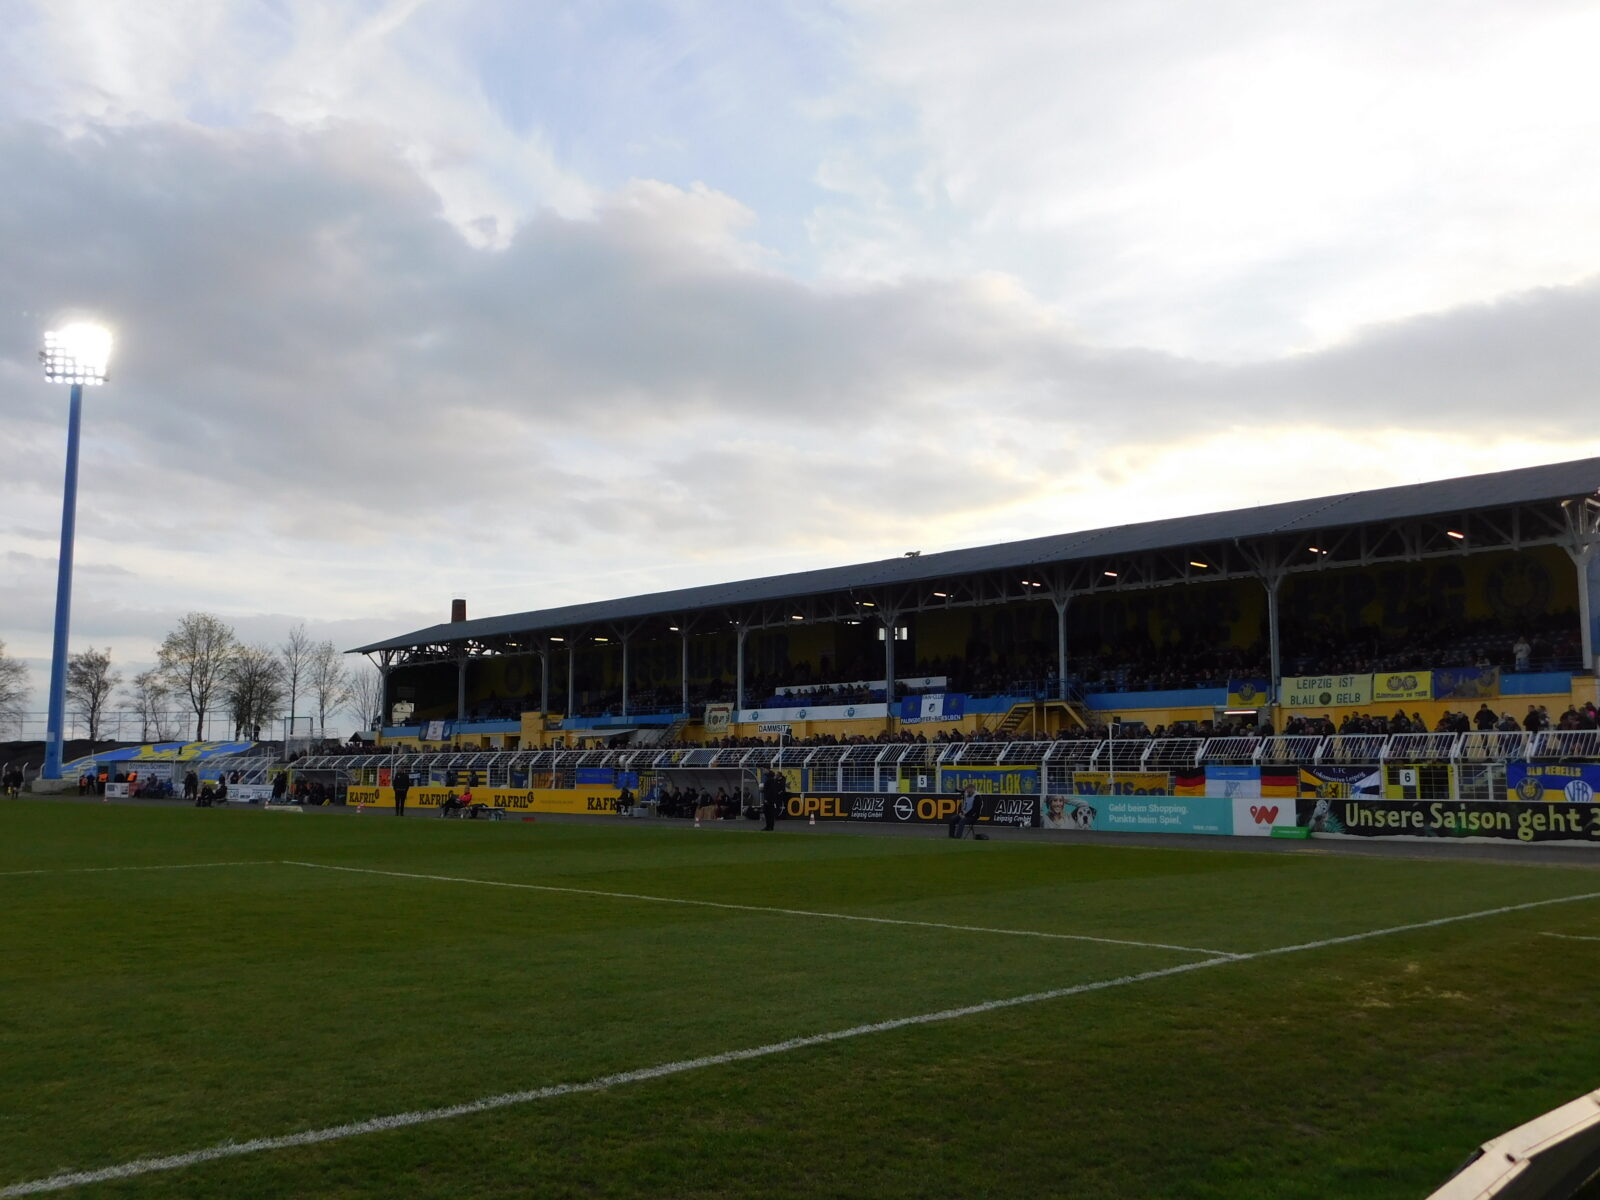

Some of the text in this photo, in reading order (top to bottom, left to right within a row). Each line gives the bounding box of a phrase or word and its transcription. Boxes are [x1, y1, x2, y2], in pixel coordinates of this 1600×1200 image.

[1296, 677, 1355, 690] LEIPZIG IST
[1290, 693, 1361, 705] BLAU GELB
[919, 776, 925, 786] 5
[1404, 772, 1411, 783] 6
[349, 791, 376, 804] KAFRIL
[494, 794, 529, 809] KAFRIL
[587, 797, 618, 811] KAFR
[787, 796, 885, 817] OPEL AMZ
[994, 799, 1034, 815] AMZ
[1108, 803, 1189, 815] Geld beim Shopping.
[993, 814, 1013, 824] Leipzig
[1108, 814, 1182, 826] Punkte beim Spiel.
[1345, 802, 1424, 828] Unsere
[1430, 802, 1511, 830] Saison
[1517, 804, 1583, 841] geht
